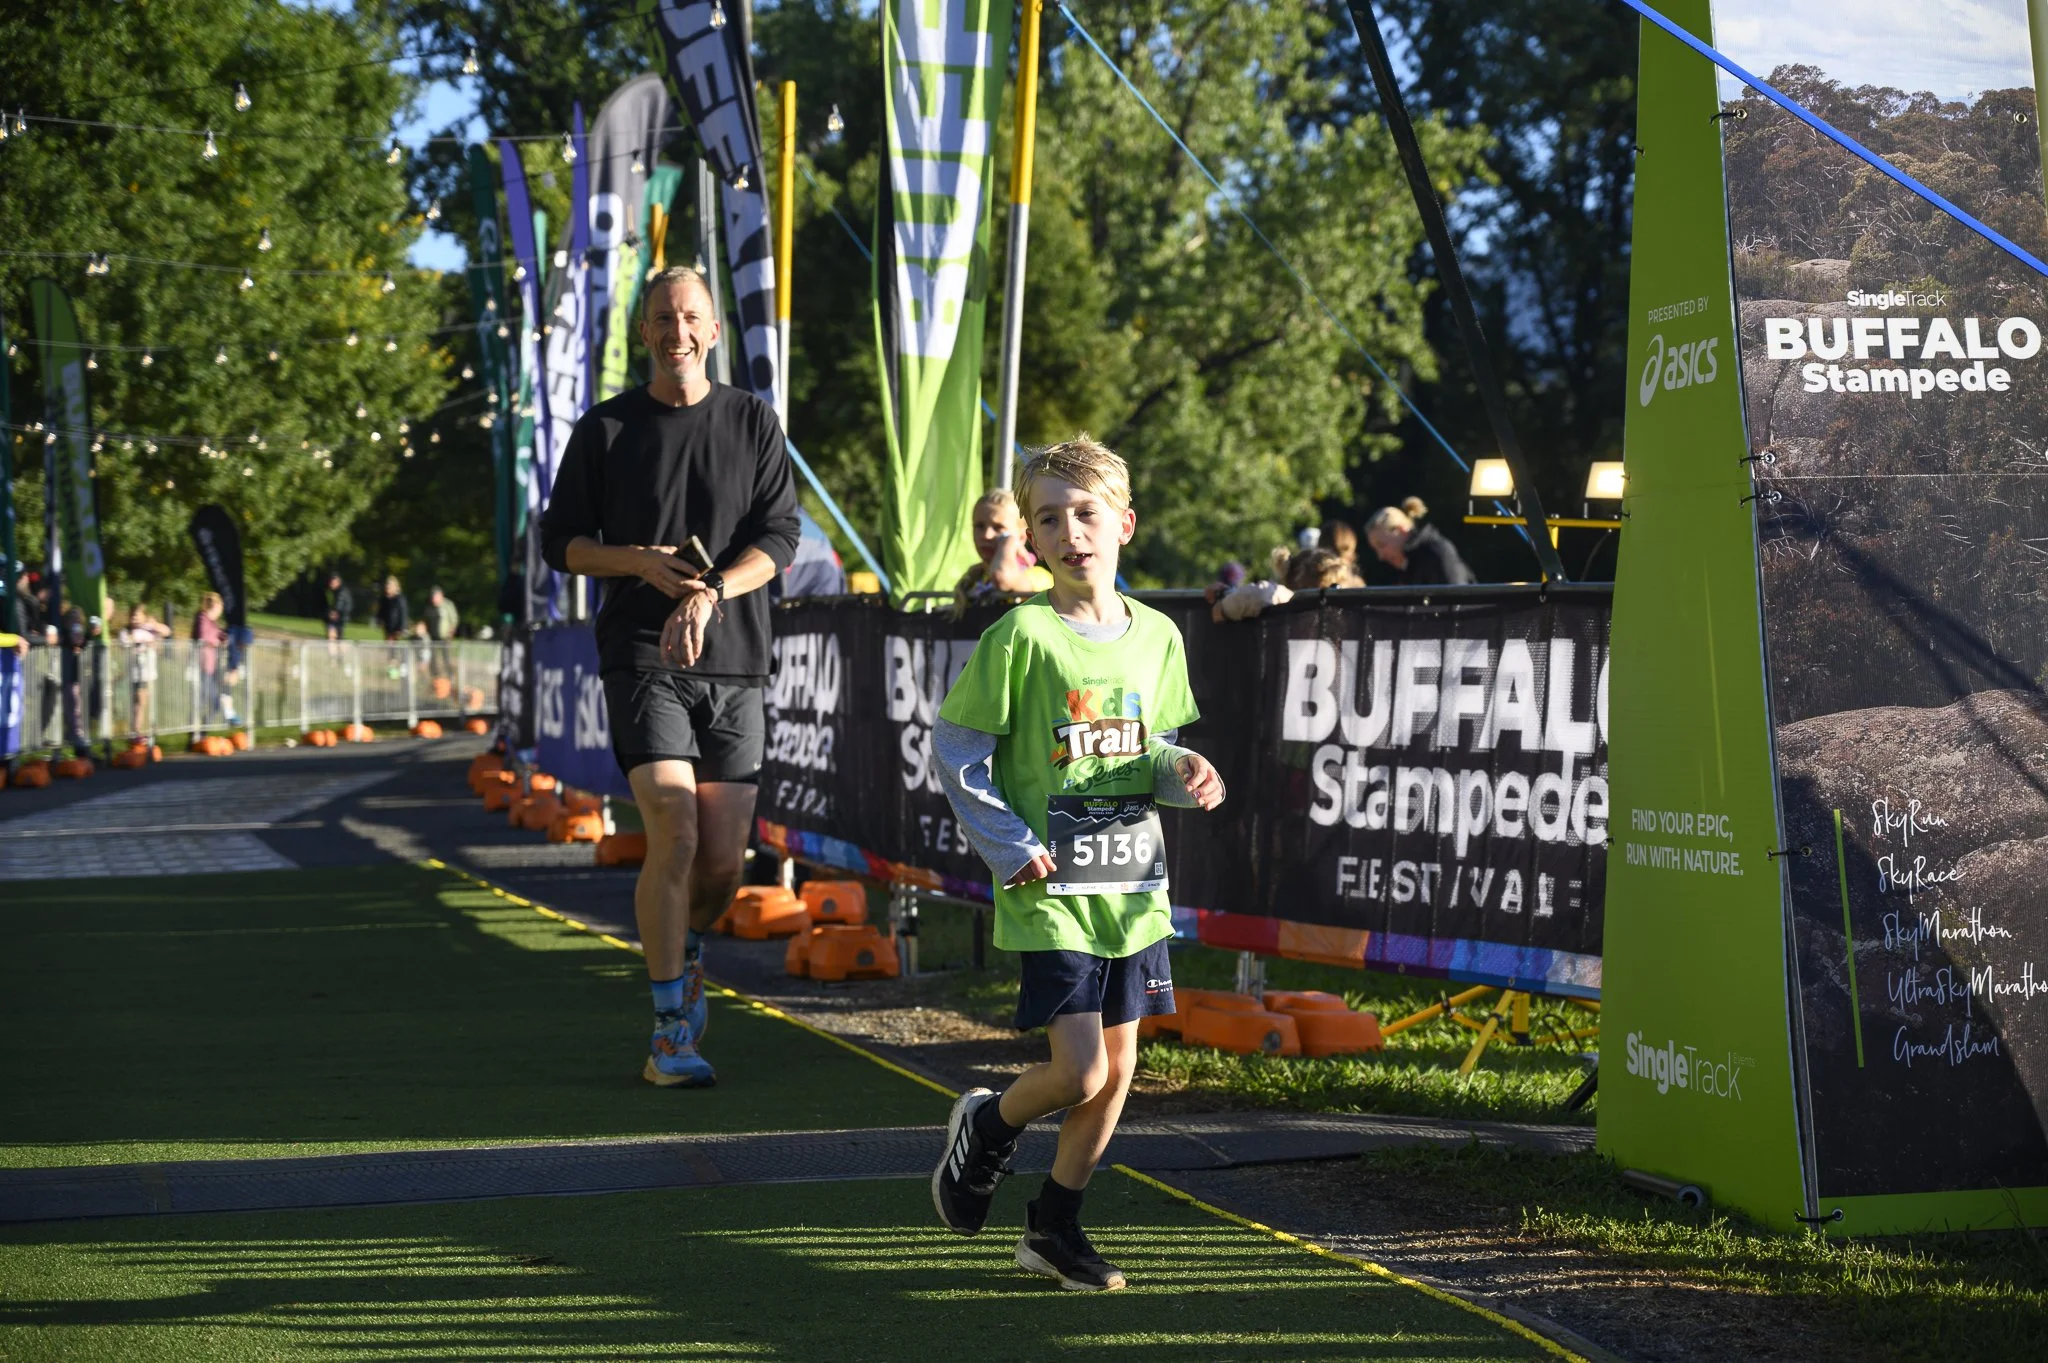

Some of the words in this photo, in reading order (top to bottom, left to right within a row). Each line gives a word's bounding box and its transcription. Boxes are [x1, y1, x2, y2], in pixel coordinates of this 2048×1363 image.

[1648, 300, 1696, 324] PRESENTED
[1698, 296, 1710, 313] BY
[1847, 289, 1947, 311] SingleTrack
[1765, 316, 2042, 360] BUFFALO
[1802, 361, 2011, 399] Stampede
[1282, 638, 1610, 754] BUFFAL
[1057, 720, 1142, 760] Trail
[1083, 800, 1119, 808] BUFFALO
[1308, 743, 1610, 858] Stampede
[1632, 808, 1657, 832] FIND
[1659, 811, 1694, 835] YOUR
[1697, 813, 1734, 843] EPIC,
[1872, 796, 1950, 848] SkyRun
[1072, 831, 1152, 867] 5136
[1627, 842, 1648, 866] RUN
[1650, 845, 1681, 870] WITH
[1684, 849, 1745, 876] NATURE.
[1877, 852, 1967, 905] SkyRace
[1882, 906, 2013, 962] SkyMarathon
[1626, 1029, 1742, 1102] SingleTrack
[1893, 1023, 2001, 1069] Grandslam
